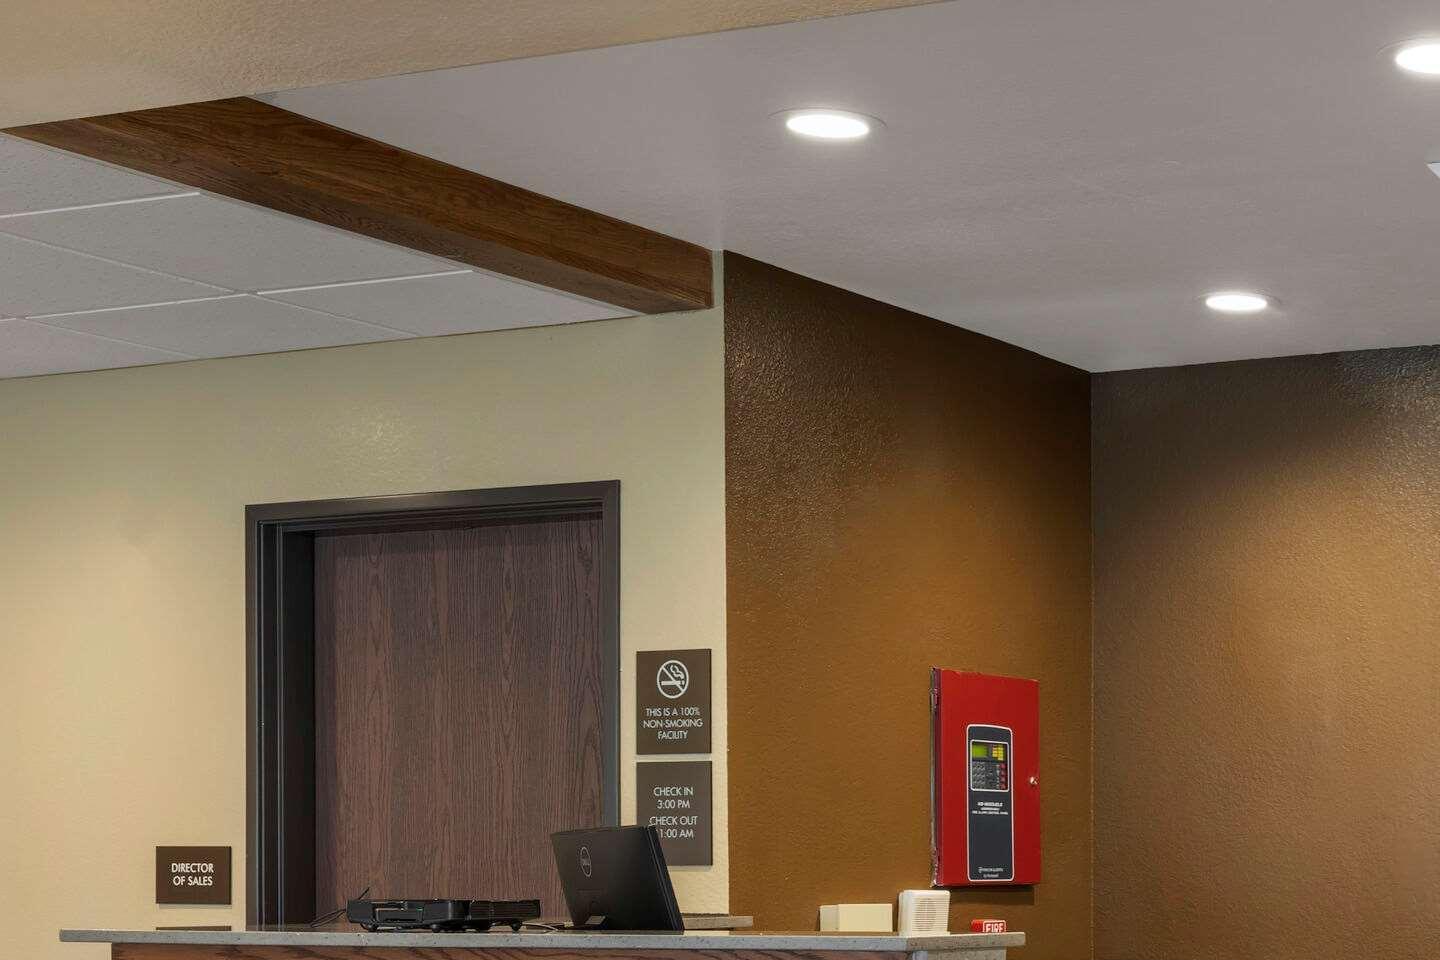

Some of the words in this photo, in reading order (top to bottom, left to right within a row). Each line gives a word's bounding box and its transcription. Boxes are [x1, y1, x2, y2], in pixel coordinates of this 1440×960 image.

[646, 707, 662, 717] THIS
[663, 707, 671, 716] IS
[672, 707, 678, 716] A
[680, 707, 701, 716] 100%
[657, 730, 688, 740] FACILITY
[653, 786, 682, 796] CHECK
[684, 786, 694, 796] IN
[657, 799, 676, 809] 3:00
[677, 799, 691, 809] PM
[649, 816, 678, 826] CHECK
[679, 815, 698, 826] OUT
[656, 829, 678, 838] 1:00
[679, 829, 694, 839] AM
[171, 862, 214, 873] DIRECTOR
[172, 875, 186, 886] OF
[187, 875, 213, 886] SALES
[985, 923, 1004, 932] FIRE
